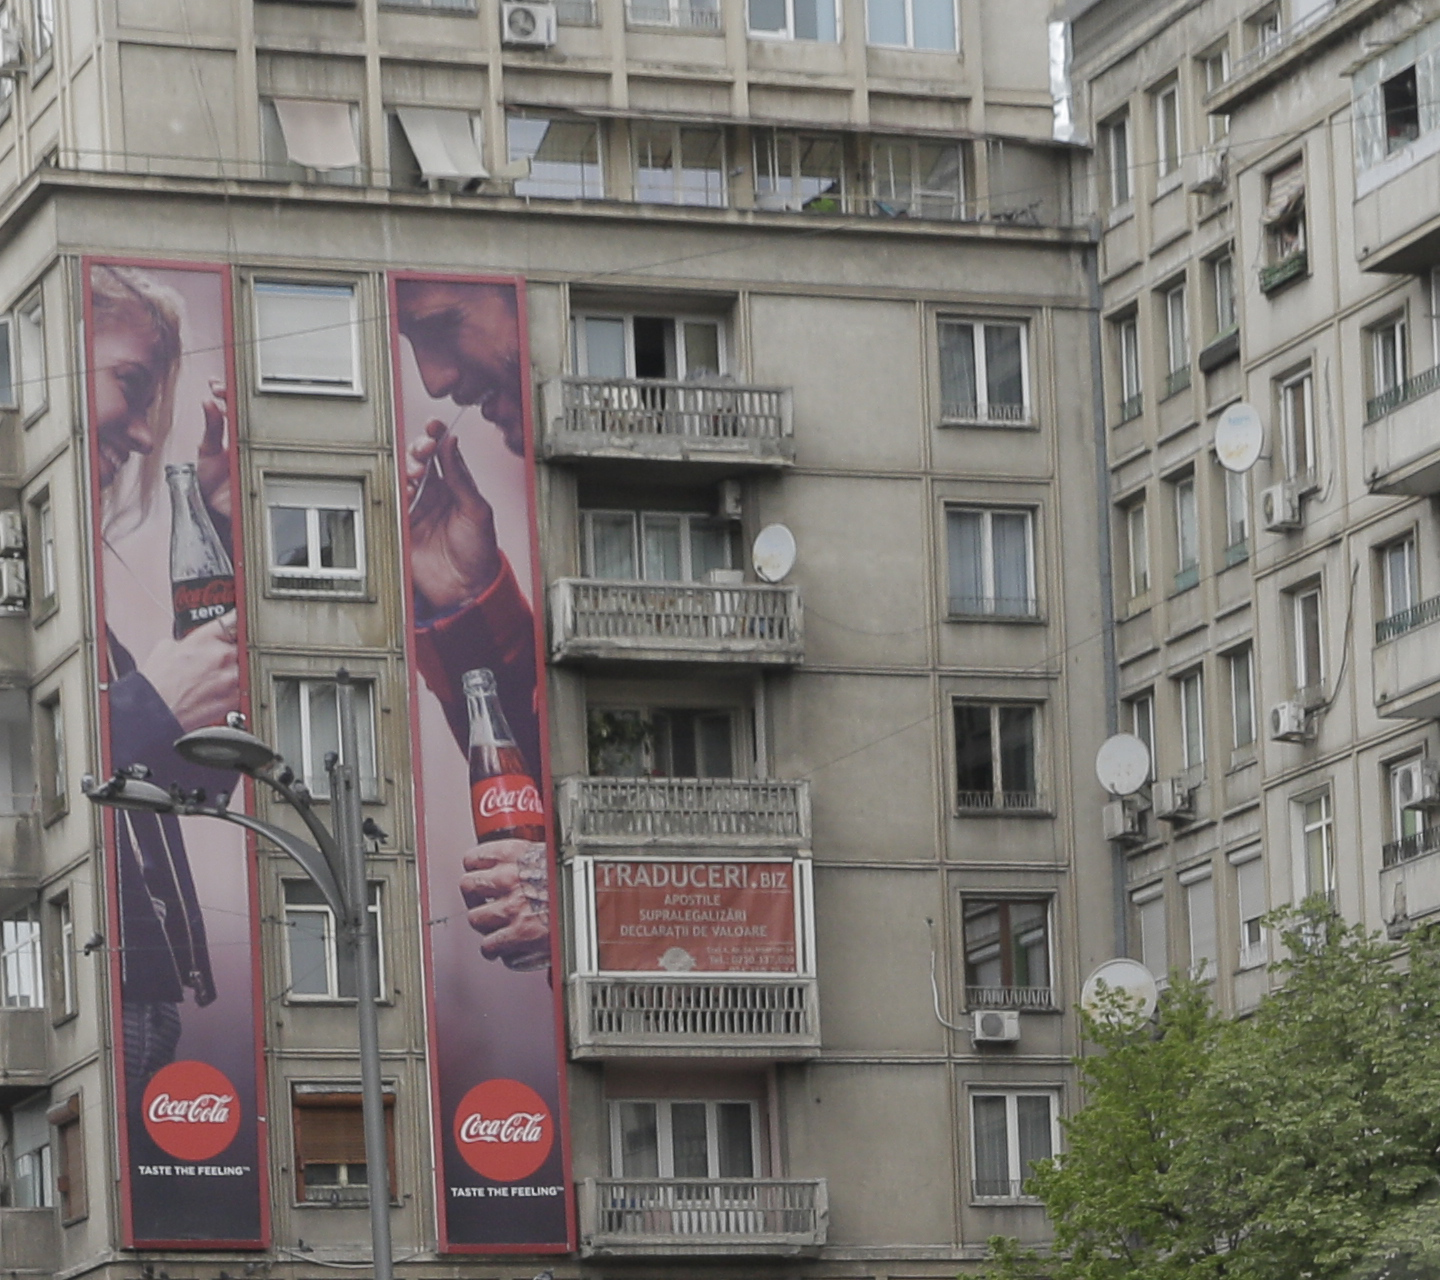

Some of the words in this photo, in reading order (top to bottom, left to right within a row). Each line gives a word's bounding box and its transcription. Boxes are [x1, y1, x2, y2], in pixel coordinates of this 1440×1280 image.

[189, 605, 225, 620] zero
[664, 894, 721, 906] APOSTILE
[693, 925, 708, 937] DE
[712, 925, 767, 937] VALOARE
[138, 1166, 172, 1175] TASTE
[174, 1166, 196, 1175] THE
[451, 1187, 485, 1197] TASTE
[487, 1187, 509, 1197] THE
